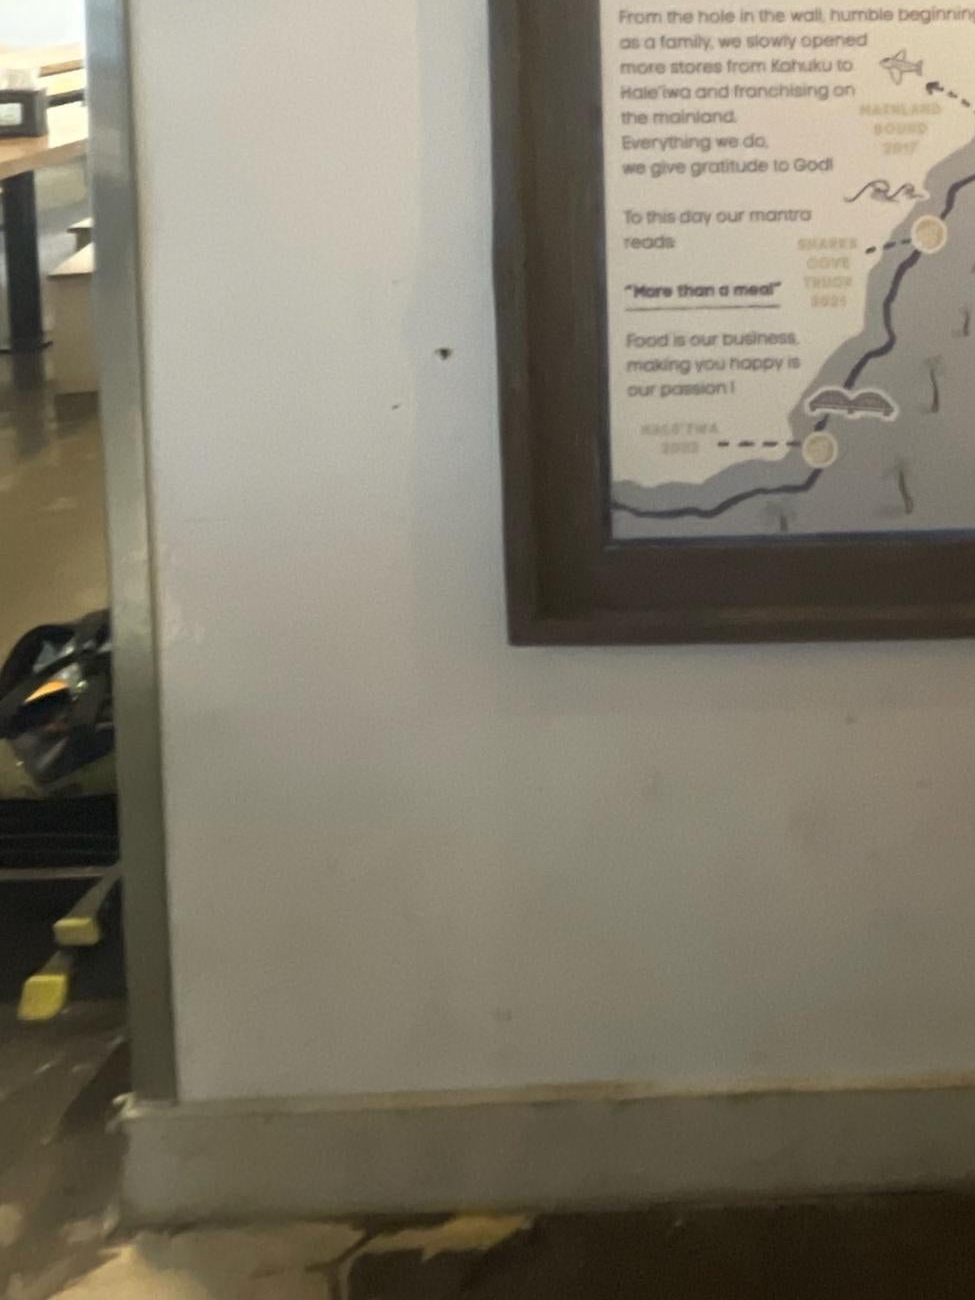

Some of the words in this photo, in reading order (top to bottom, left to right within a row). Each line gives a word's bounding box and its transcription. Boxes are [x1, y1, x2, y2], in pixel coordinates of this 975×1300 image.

[619, 10, 662, 24] From
[666, 11, 694, 24] the
[698, 10, 736, 24] hole
[740, 10, 755, 22] in
[758, 9, 785, 23] the
[830, 8, 894, 22] humble
[620, 63, 666, 75] more
[670, 61, 723, 75] stores
[726, 59, 767, 74] from
[771, 59, 833, 73] Kahuku
[836, 59, 853, 72] to
[695, 85, 730, 99] and
[732, 84, 830, 102] franchising
[833, 85, 855, 97] on
[621, 112, 649, 124] the
[622, 134, 712, 153] Everything
[715, 137, 739, 148] we
[624, 209, 643, 226] To
[646, 211, 677, 224] this
[678, 210, 712, 228] day
[716, 211, 745, 223] our
[749, 209, 812, 222] mantra
[677, 283, 715, 297] than
[718, 285, 730, 297] a
[626, 333, 670, 348] Food
[673, 335, 687, 347] is
[688, 335, 718, 347] our
[626, 359, 692, 375] making
[695, 359, 726, 373] you
[729, 357, 783, 373] happy
[787, 357, 801, 369] is
